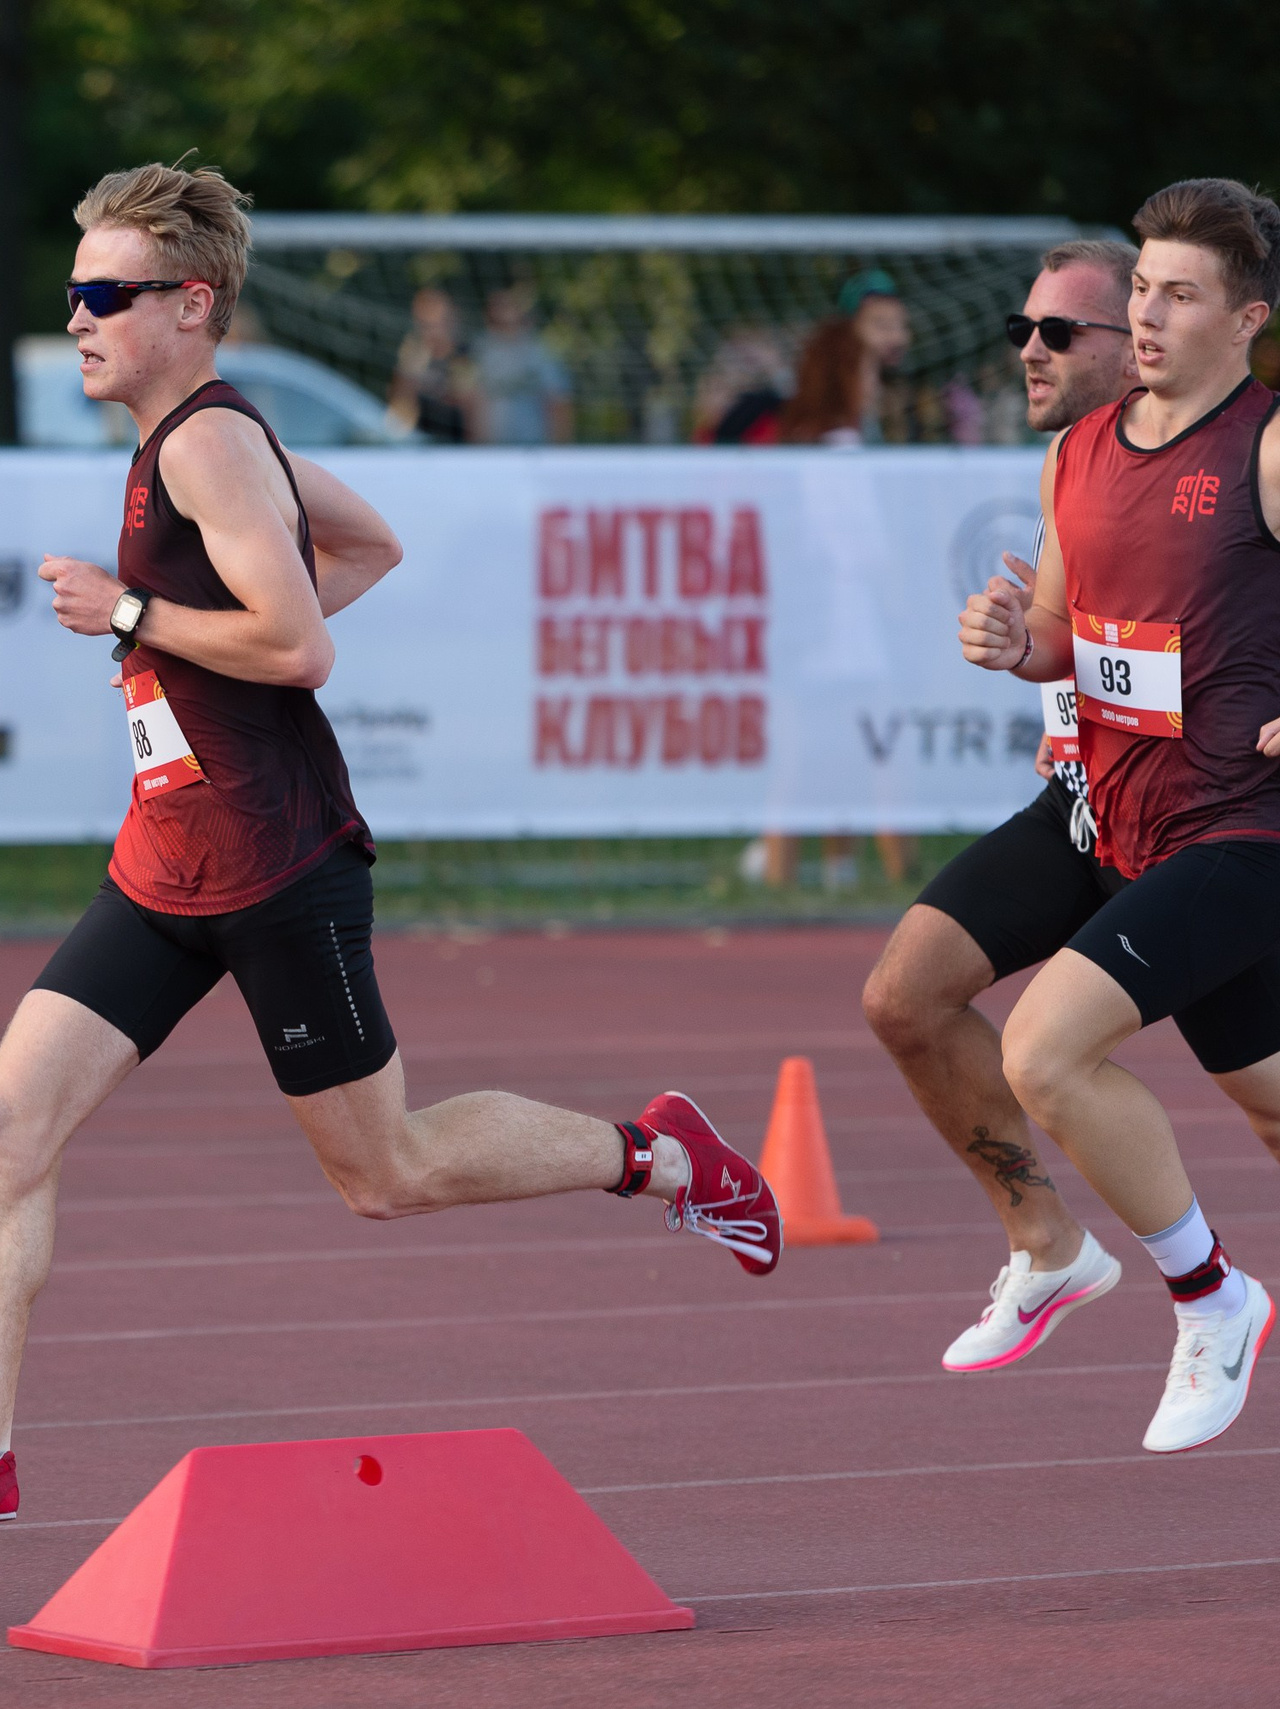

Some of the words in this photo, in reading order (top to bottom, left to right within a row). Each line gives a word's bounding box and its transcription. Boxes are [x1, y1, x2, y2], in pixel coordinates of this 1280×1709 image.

[537, 506, 767, 599] БИТВА
[537, 616, 767, 677] БЕГОВЫХ
[1099, 656, 1132, 696] 93
[534, 694, 768, 767] КЛУБОВ
[1056, 692, 1078, 726] 95
[1101, 708, 1115, 722] 3000
[1115, 713, 1139, 727] метров
[132, 719, 152, 759] 88
[859, 709, 992, 766] VTR
